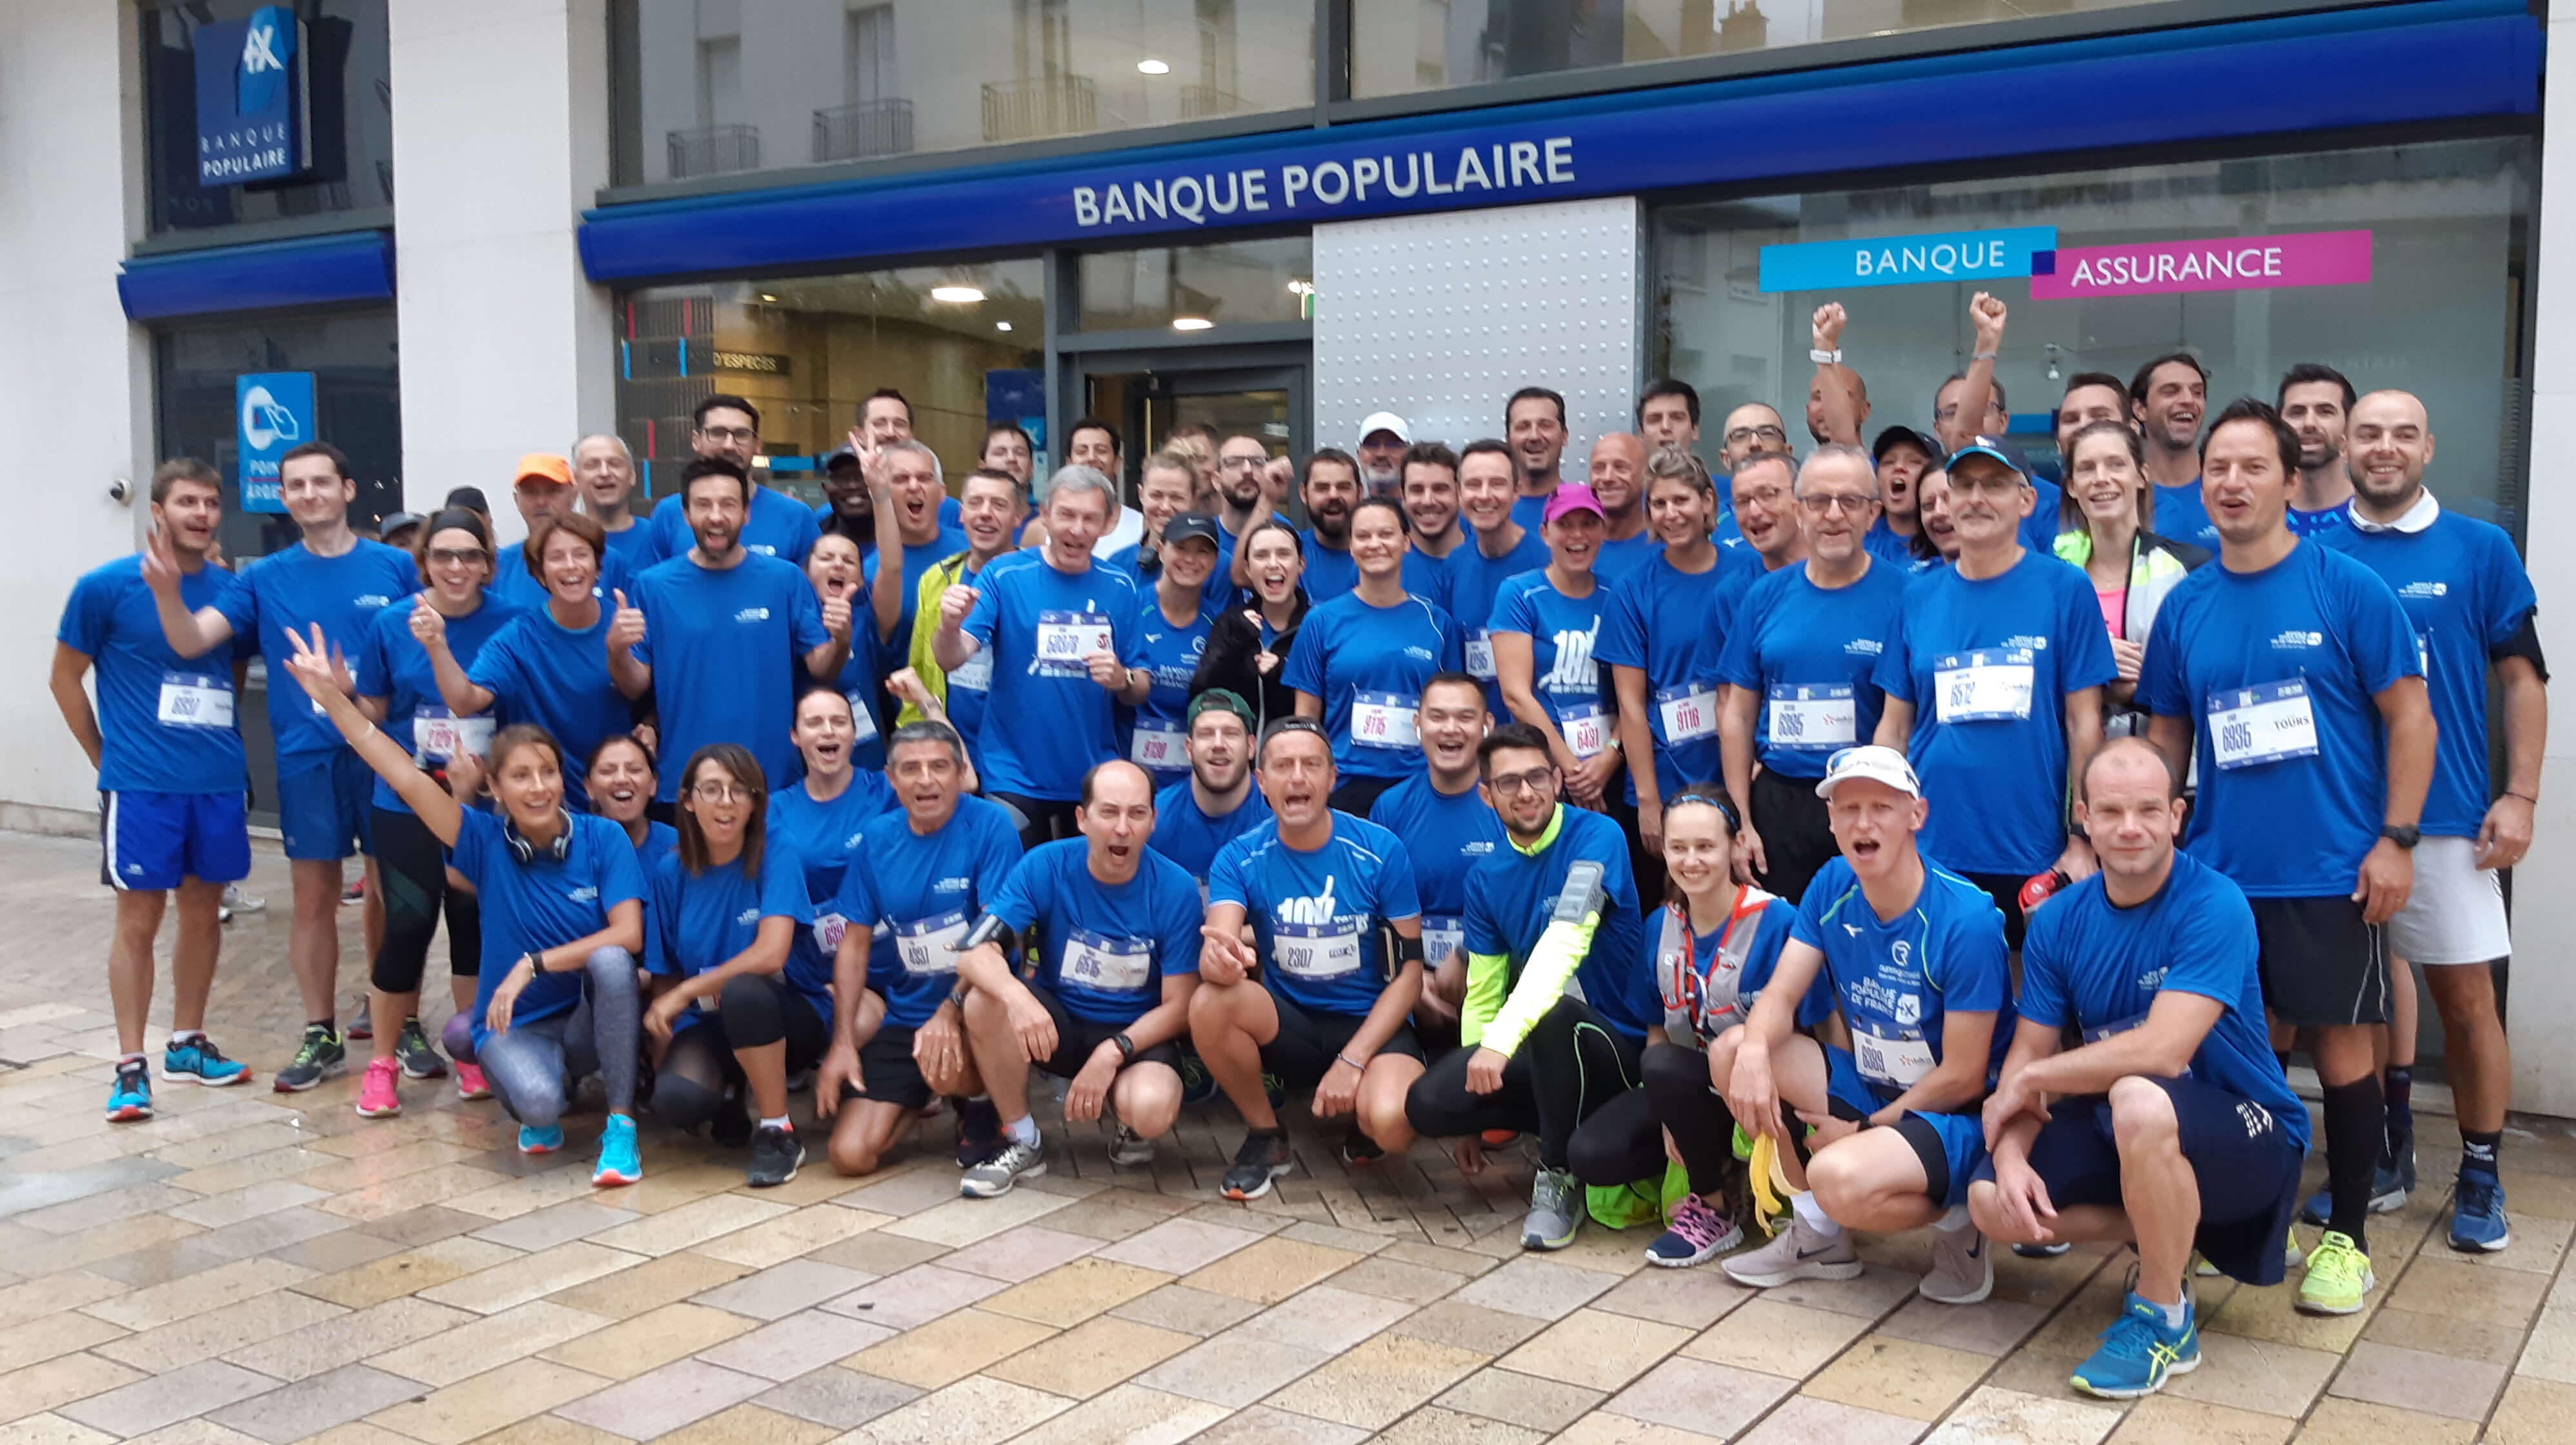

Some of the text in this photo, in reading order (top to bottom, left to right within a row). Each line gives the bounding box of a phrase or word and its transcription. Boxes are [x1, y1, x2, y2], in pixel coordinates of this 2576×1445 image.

[201, 123, 285, 153] BANQUE
[202, 148, 286, 177] POPULAIRE
[1073, 137, 1575, 224] BANQUE POPULAIRE
[1856, 241, 2004, 276] BANQUE
[2071, 247, 2282, 288] ASSURANCE
[2274, 714, 2310, 732] TOURS
